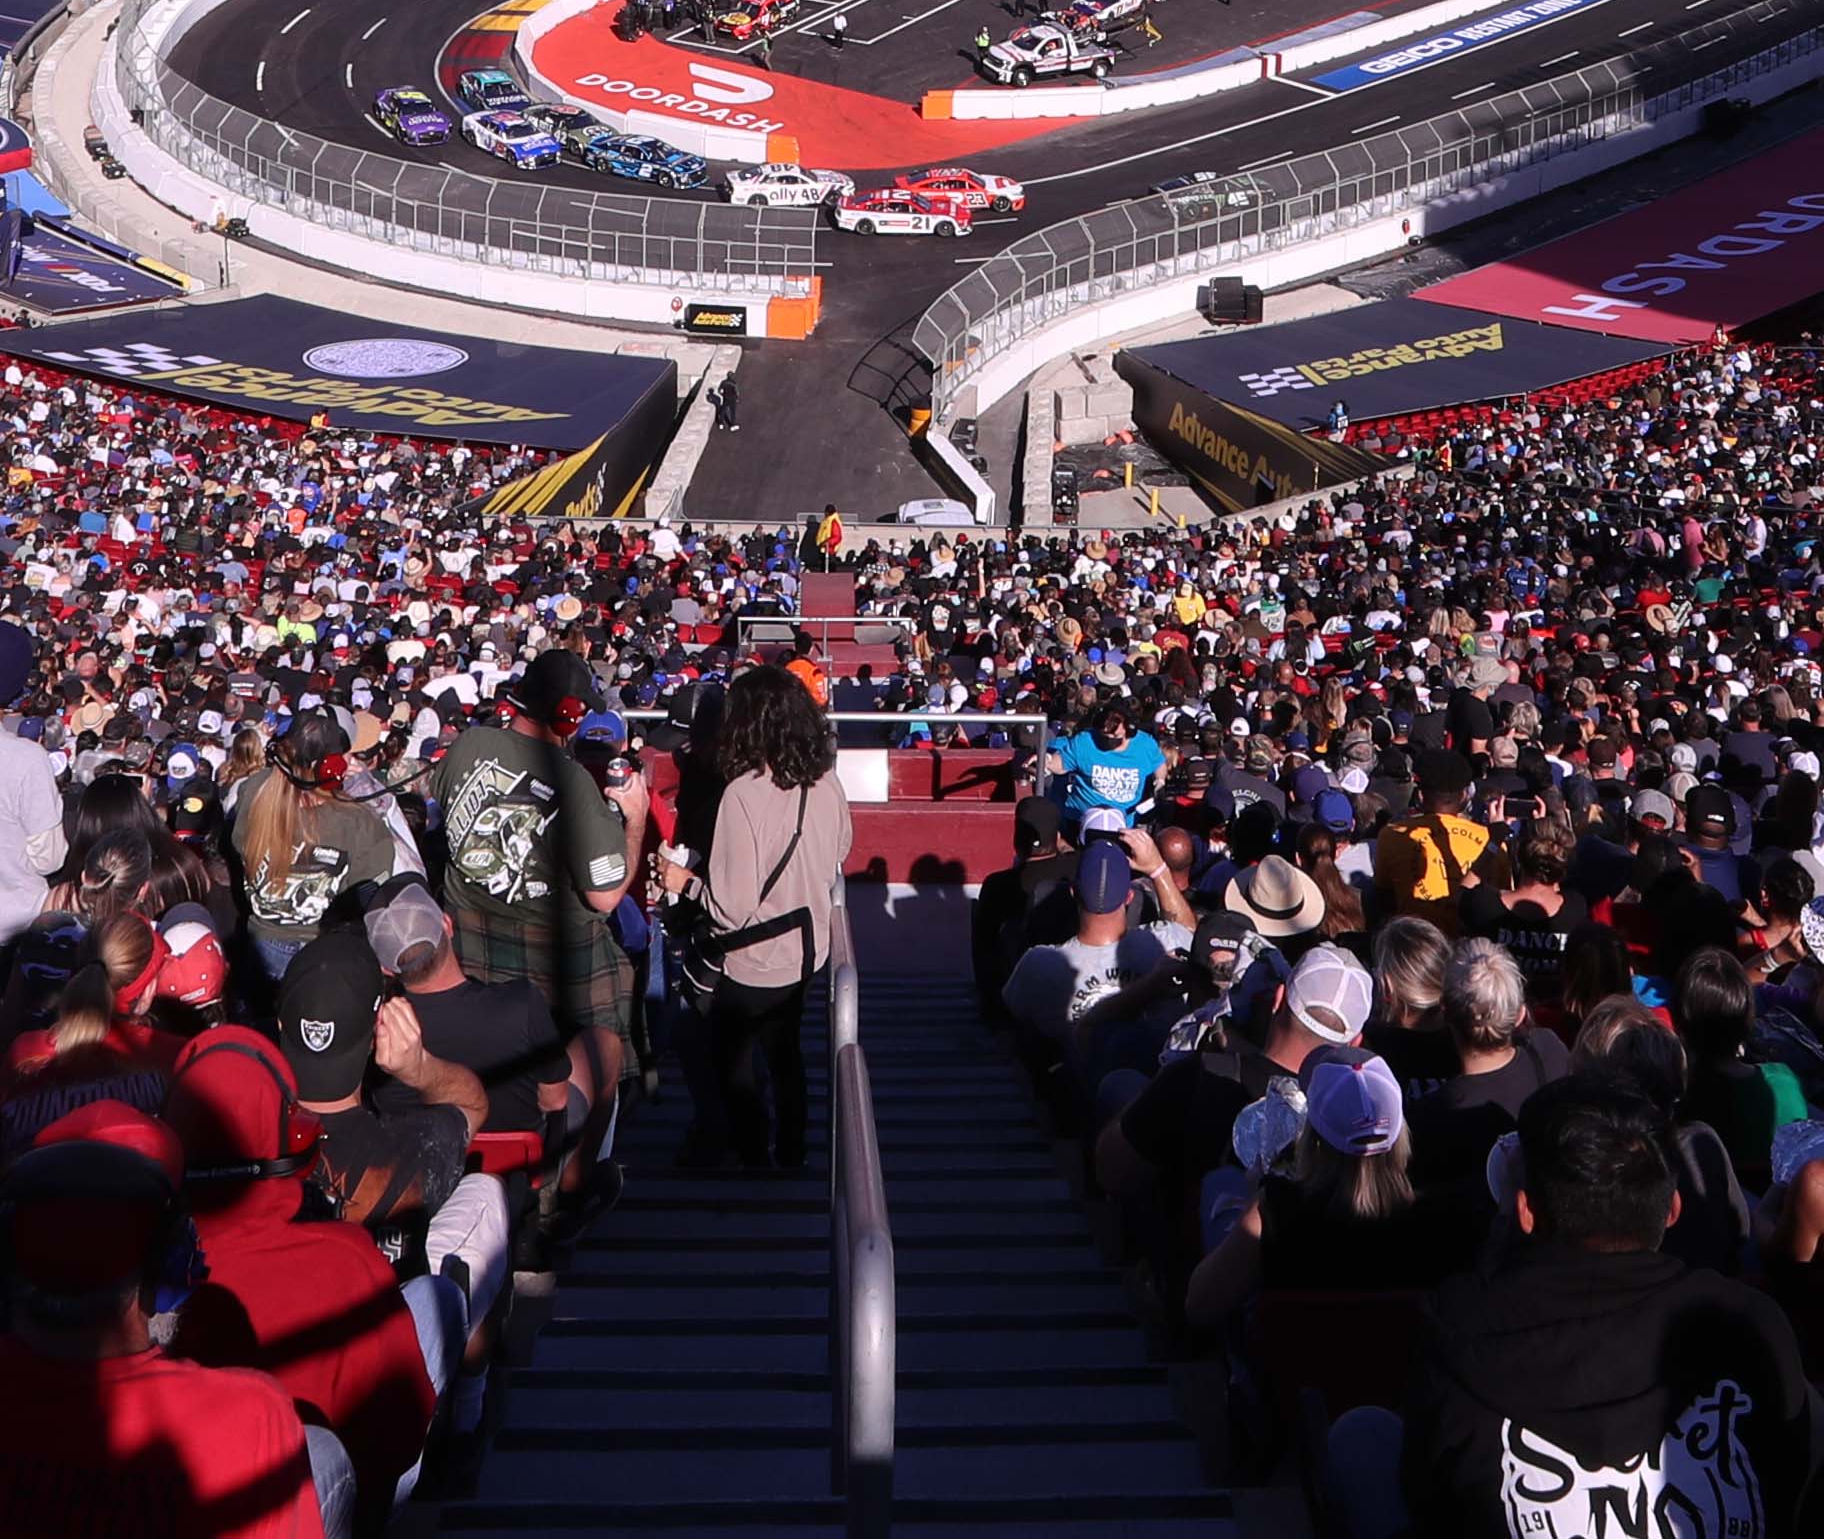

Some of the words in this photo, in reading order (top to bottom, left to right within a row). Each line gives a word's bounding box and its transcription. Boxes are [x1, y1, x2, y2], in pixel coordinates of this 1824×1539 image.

[1359, 37, 1464, 74] GEICO
[1454, 7, 1539, 42] RESTART
[575, 72, 785, 134] DOORDASH
[553, 130, 567, 145] 42
[638, 162, 652, 177] 2
[769, 188, 797, 203] ally
[801, 187, 821, 202] 48
[965, 193, 985, 206] 23
[1227, 191, 1250, 206] 45
[911, 216, 930, 229] 21
[1412, 323, 1502, 350] Auto
[1314, 343, 1414, 371] Parts
[1322, 333, 1505, 381] Advance
[174, 373, 505, 426] Advance
[393, 386, 574, 423] Auto
[1168, 401, 1250, 480] Advance
[1091, 764, 1139, 781] DANCE
[1524, 1511, 1545, 1533] 19
[1728, 1517, 1751, 1537] 88
